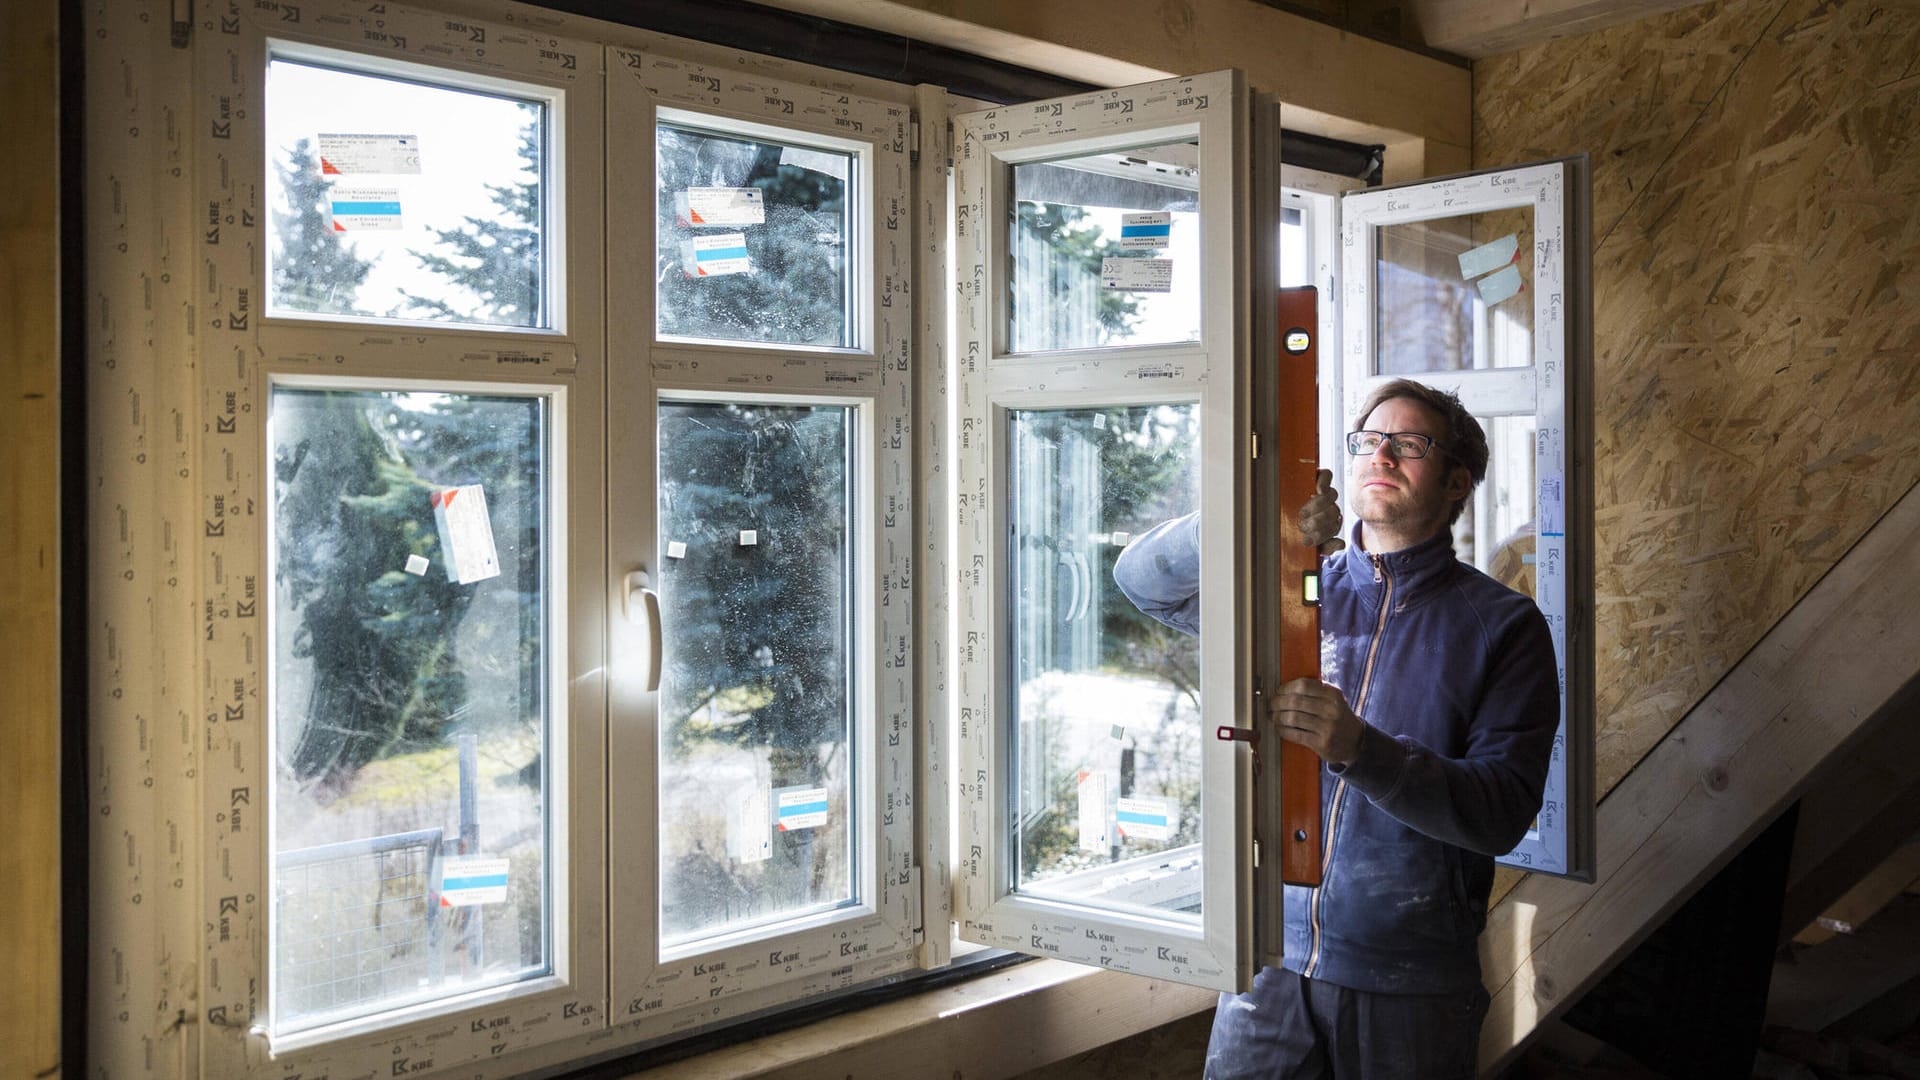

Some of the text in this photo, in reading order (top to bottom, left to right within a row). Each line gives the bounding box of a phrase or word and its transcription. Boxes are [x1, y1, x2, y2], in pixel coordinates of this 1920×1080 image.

[446, 21, 468, 32] KBE
[365, 30, 387, 41] KBE
[539, 49, 559, 61] KBE
[688, 73, 705, 84] KBE
[765, 96, 782, 106] KBE
[1103, 101, 1120, 111] KBE
[1177, 97, 1194, 107] KBE
[220, 96, 230, 119] KBE
[1035, 104, 1050, 113] KBE
[835, 118, 850, 126] KBE
[983, 134, 997, 142] KBE
[1503, 177, 1516, 185] KBE
[209, 201, 220, 225] KBE
[239, 288, 248, 311] KBE
[226, 391, 236, 414] KBE
[215, 494, 224, 517] KBE
[246, 576, 255, 598] KBE
[235, 678, 244, 701] KBE
[232, 808, 241, 833] KBE
[220, 917, 230, 942] KBE
[1099, 933, 1115, 943] KBE
[853, 942, 868, 952] KBE
[1044, 943, 1059, 952] KBE
[783, 952, 799, 962] KBE
[1172, 955, 1189, 964] KBE
[709, 962, 725, 972] KBE
[644, 999, 663, 1009] KBE
[580, 1005, 596, 1014] KB
[490, 1015, 510, 1028] KBE
[411, 1059, 433, 1072] KBE
